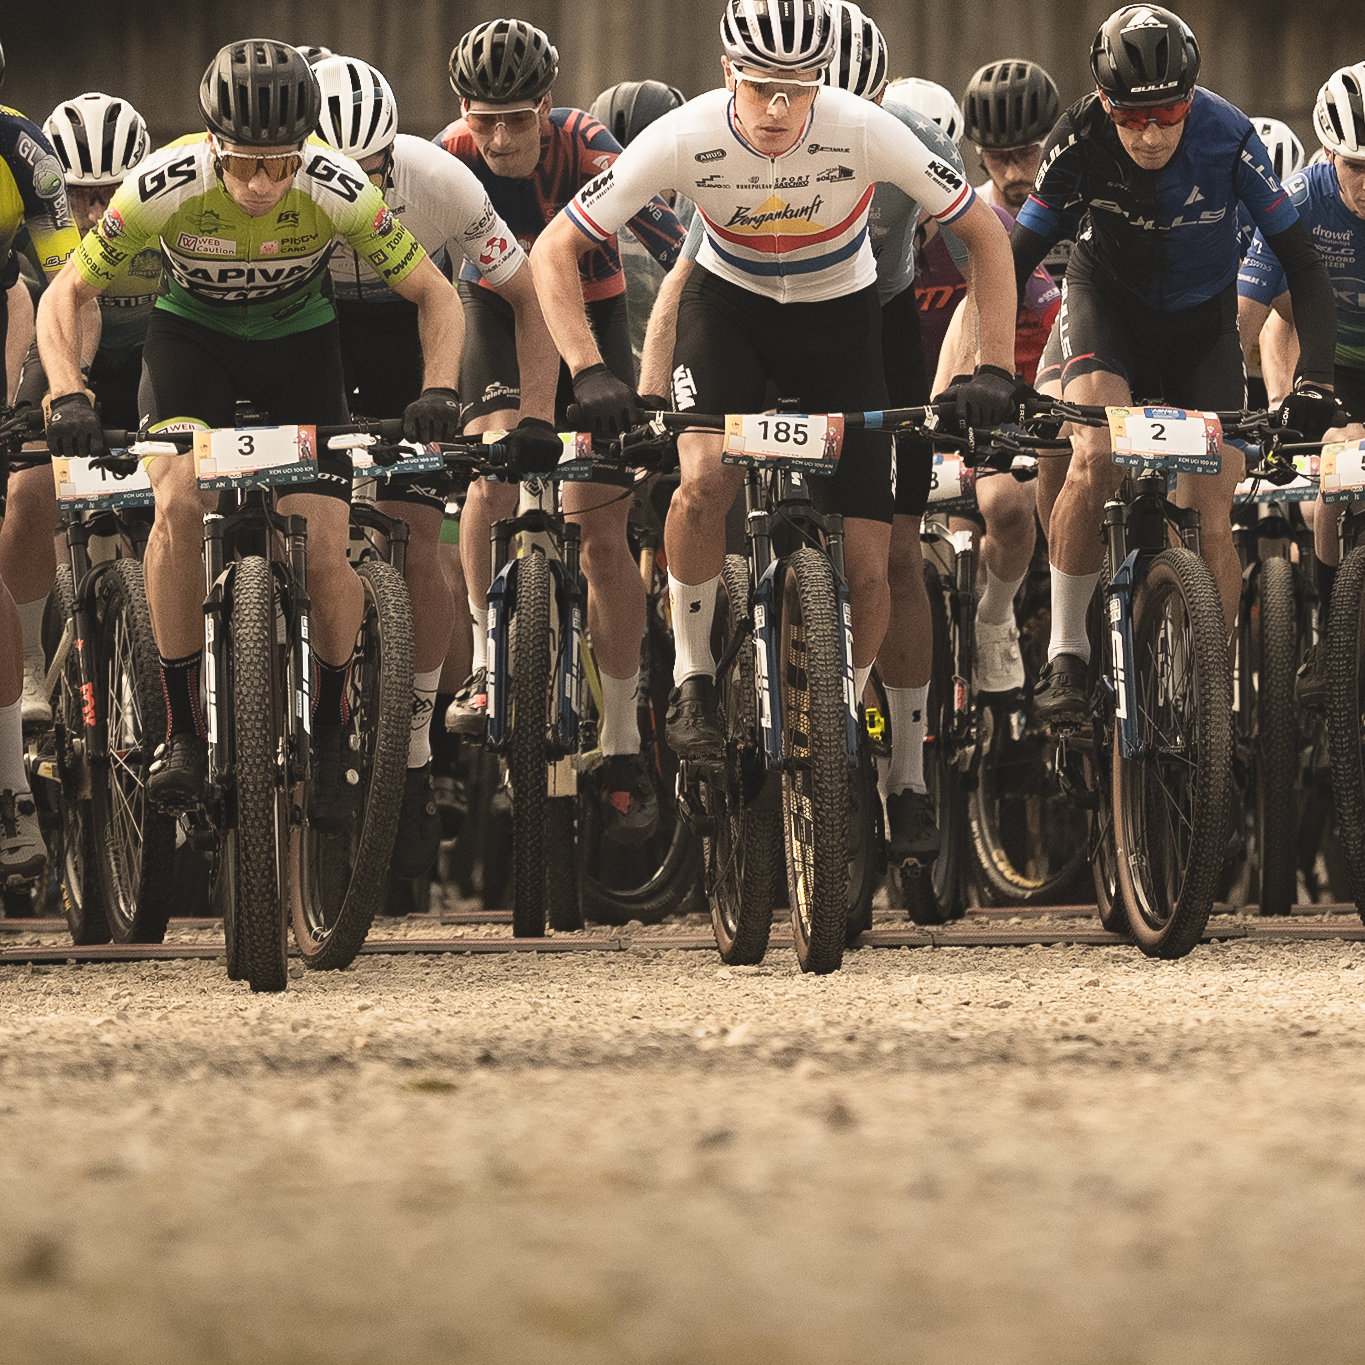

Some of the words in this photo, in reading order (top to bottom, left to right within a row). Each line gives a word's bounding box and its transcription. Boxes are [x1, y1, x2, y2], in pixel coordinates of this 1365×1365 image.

[1131, 79, 1179, 93] BULLS
[927, 159, 963, 191] KTM
[1035, 132, 1078, 192] BULL
[137, 154, 197, 203] GS
[305, 154, 365, 203] GS
[724, 193, 825, 230] Bergankunft
[196, 244, 235, 255] Caution
[197, 238, 221, 247] WEB
[757, 420, 809, 446] 185
[1150, 423, 1167, 441] 2
[237, 435, 255, 456] 3
